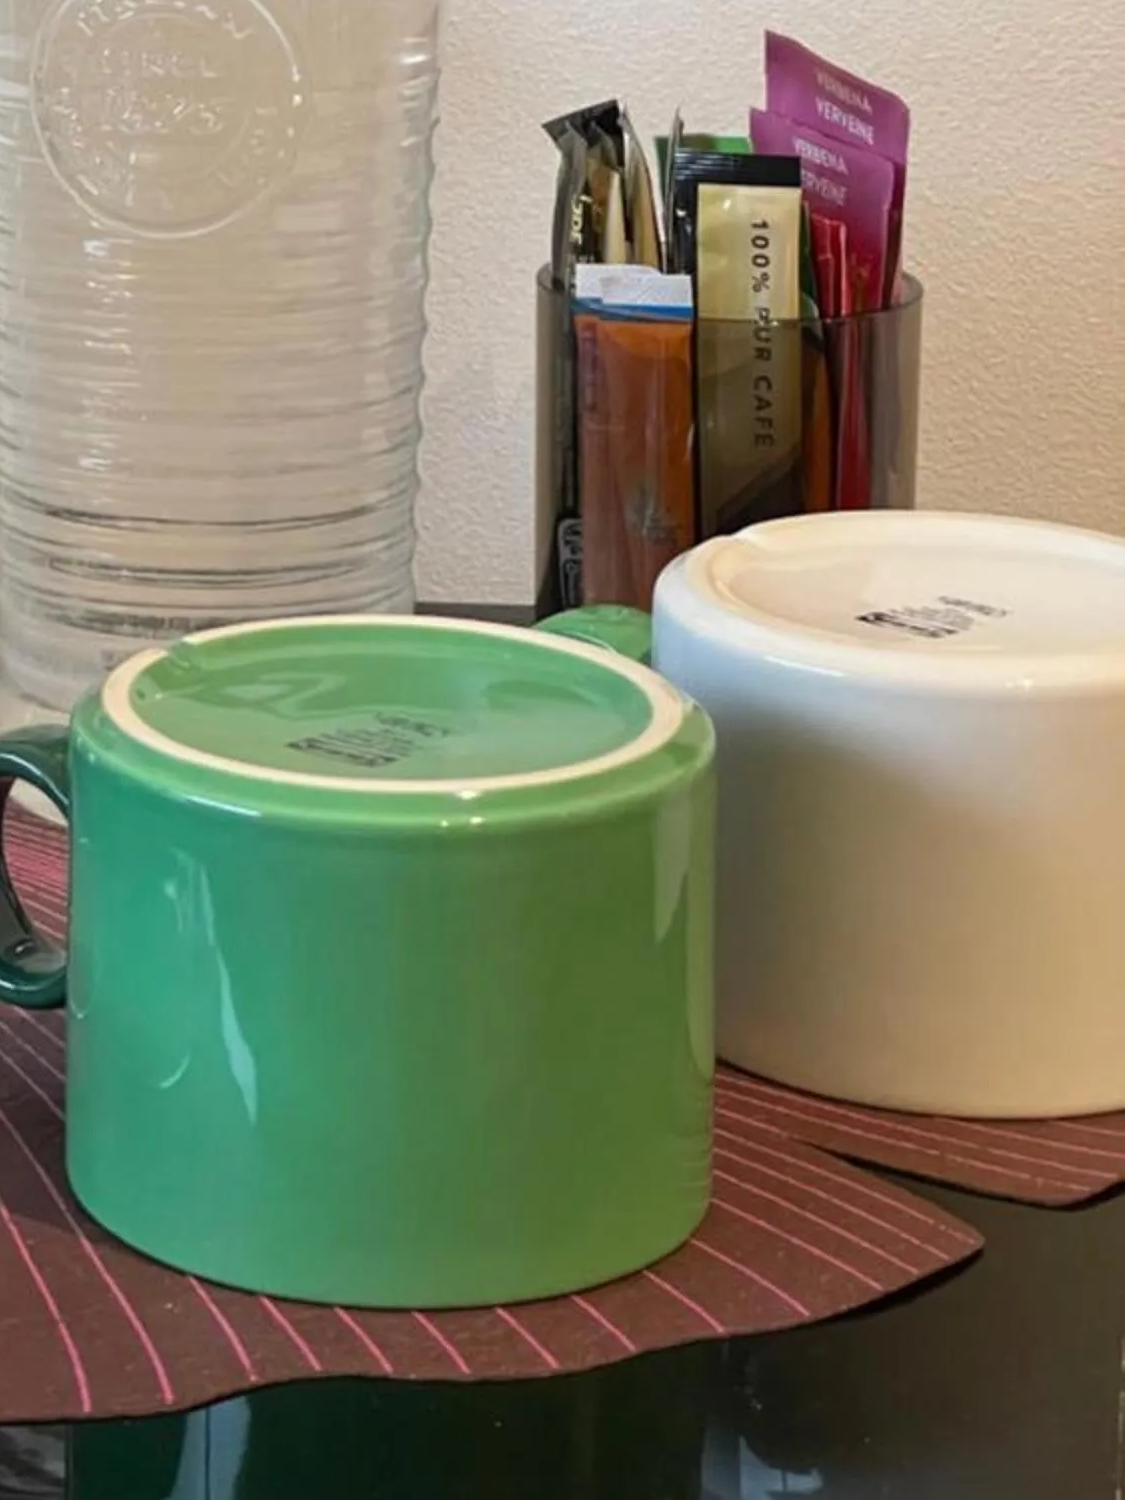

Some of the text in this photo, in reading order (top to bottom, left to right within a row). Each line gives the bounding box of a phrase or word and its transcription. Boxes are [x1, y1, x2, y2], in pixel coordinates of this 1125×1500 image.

[815, 68, 873, 116] VERBENA
[815, 97, 874, 145] VERVEINE
[792, 135, 849, 176] VERBENA
[801, 167, 847, 206] ERVEINE
[751, 219, 771, 293] 100%
[753, 307, 772, 363] PUR
